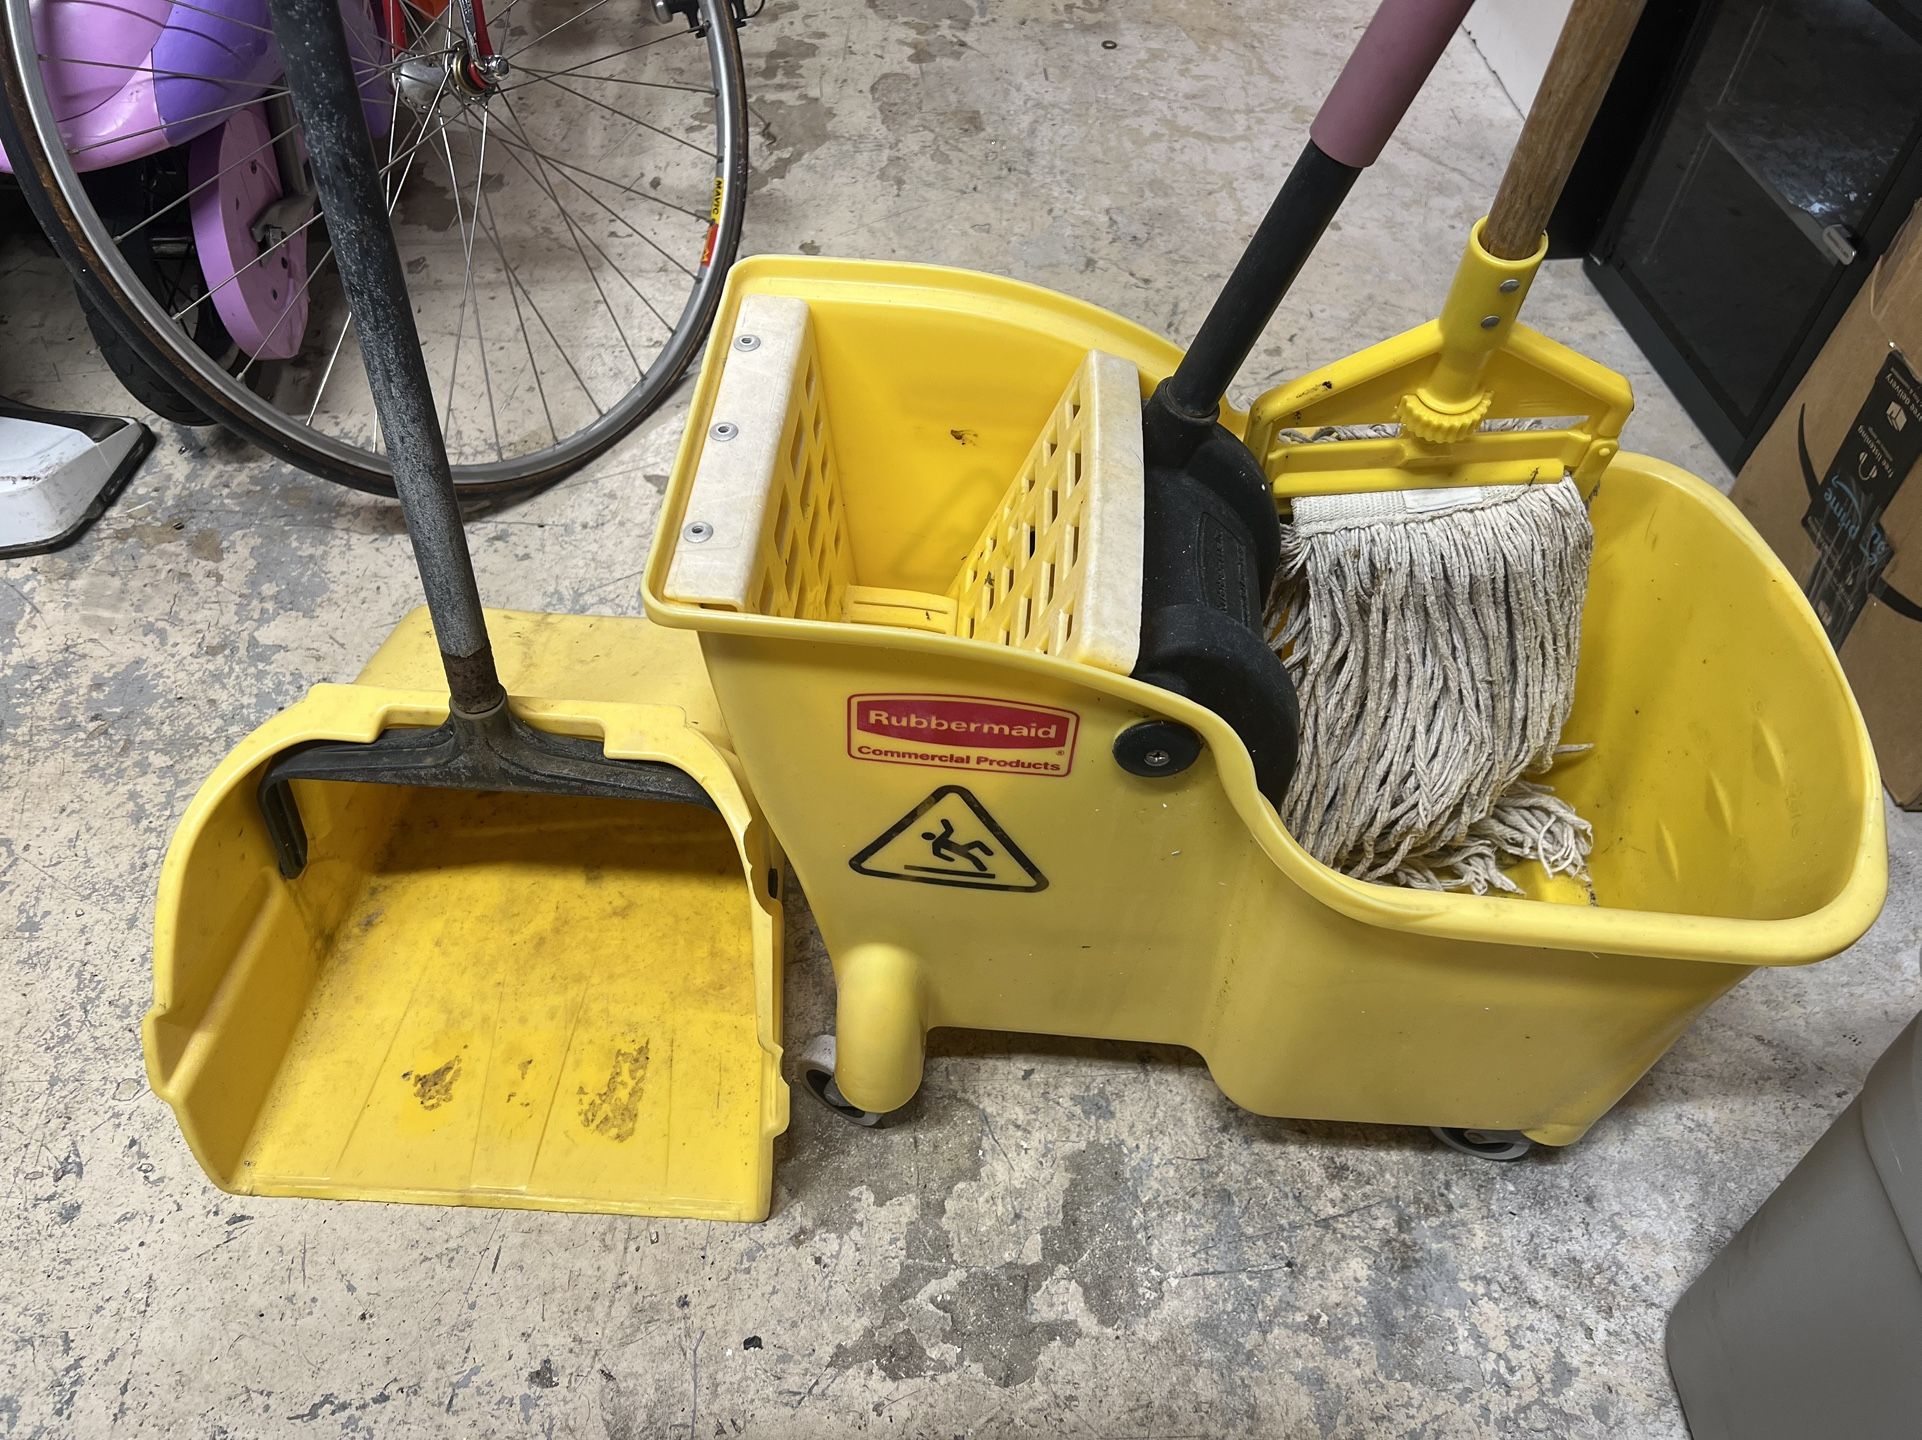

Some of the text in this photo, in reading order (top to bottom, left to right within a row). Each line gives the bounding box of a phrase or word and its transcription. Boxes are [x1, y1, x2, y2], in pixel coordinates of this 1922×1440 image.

[713, 180, 723, 215] MAVIC
[1886, 373, 1911, 406] delivery
[1858, 425, 1883, 462] listening
[1881, 458, 1894, 478] free
[1824, 487, 1860, 540] prime
[868, 709, 1057, 739] Rubbermaid
[857, 745, 1061, 772] Commercial Products
